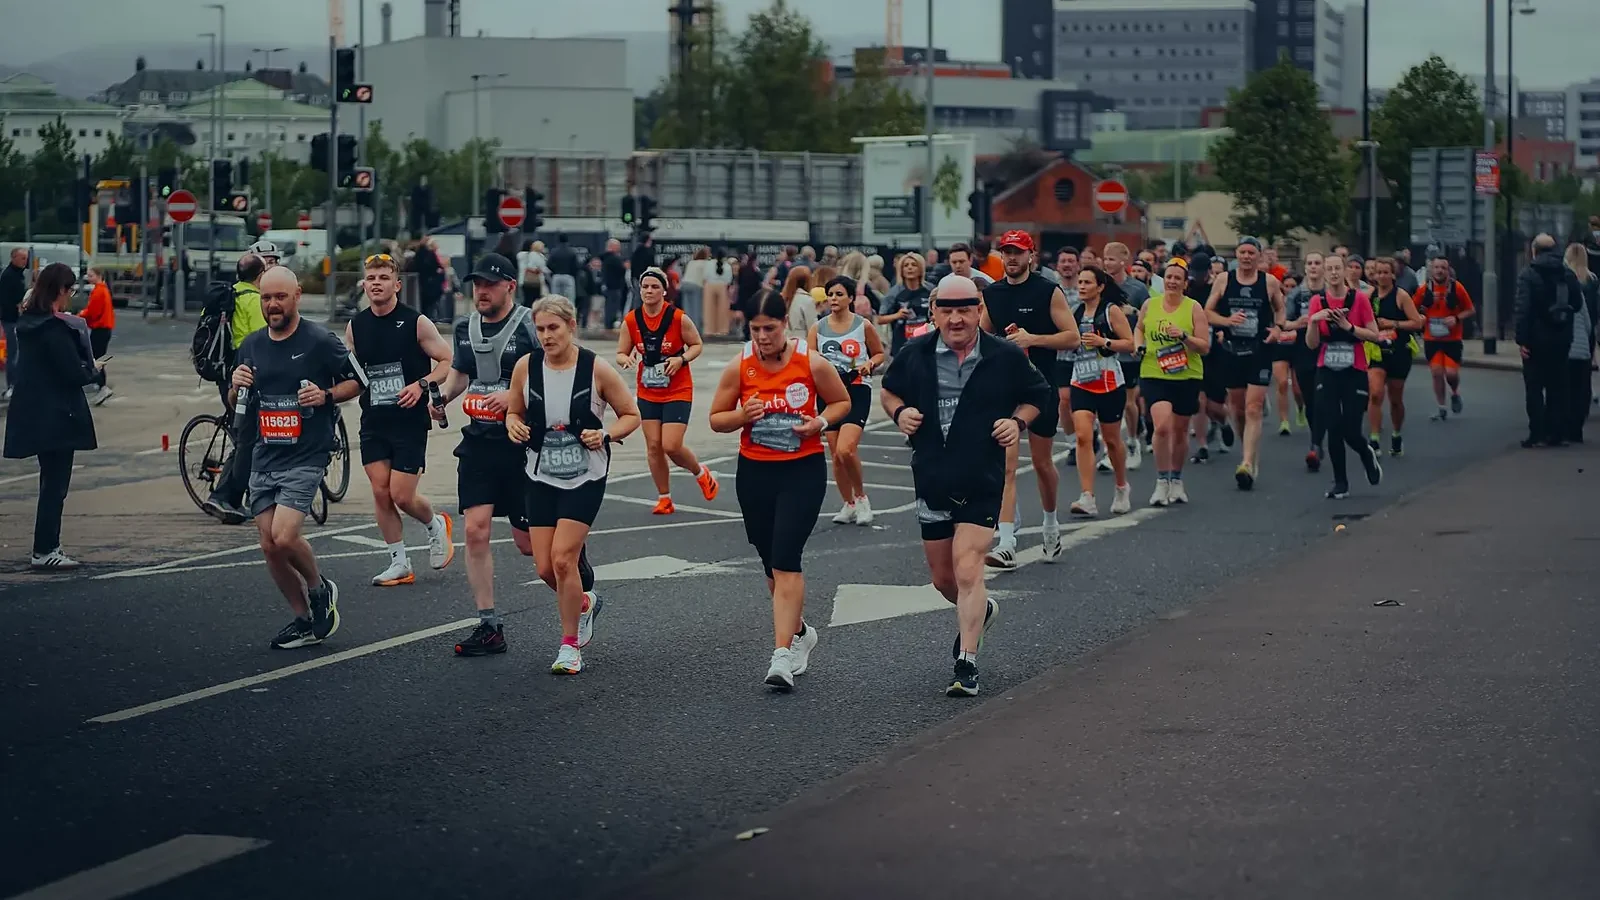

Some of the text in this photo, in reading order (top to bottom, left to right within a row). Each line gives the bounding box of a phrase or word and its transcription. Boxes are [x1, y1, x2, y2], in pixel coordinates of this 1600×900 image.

[827, 344, 855, 354] S R
[371, 378, 403, 394] 3840
[260, 415, 299, 427] 11562B
[542, 446, 583, 466] 1568
